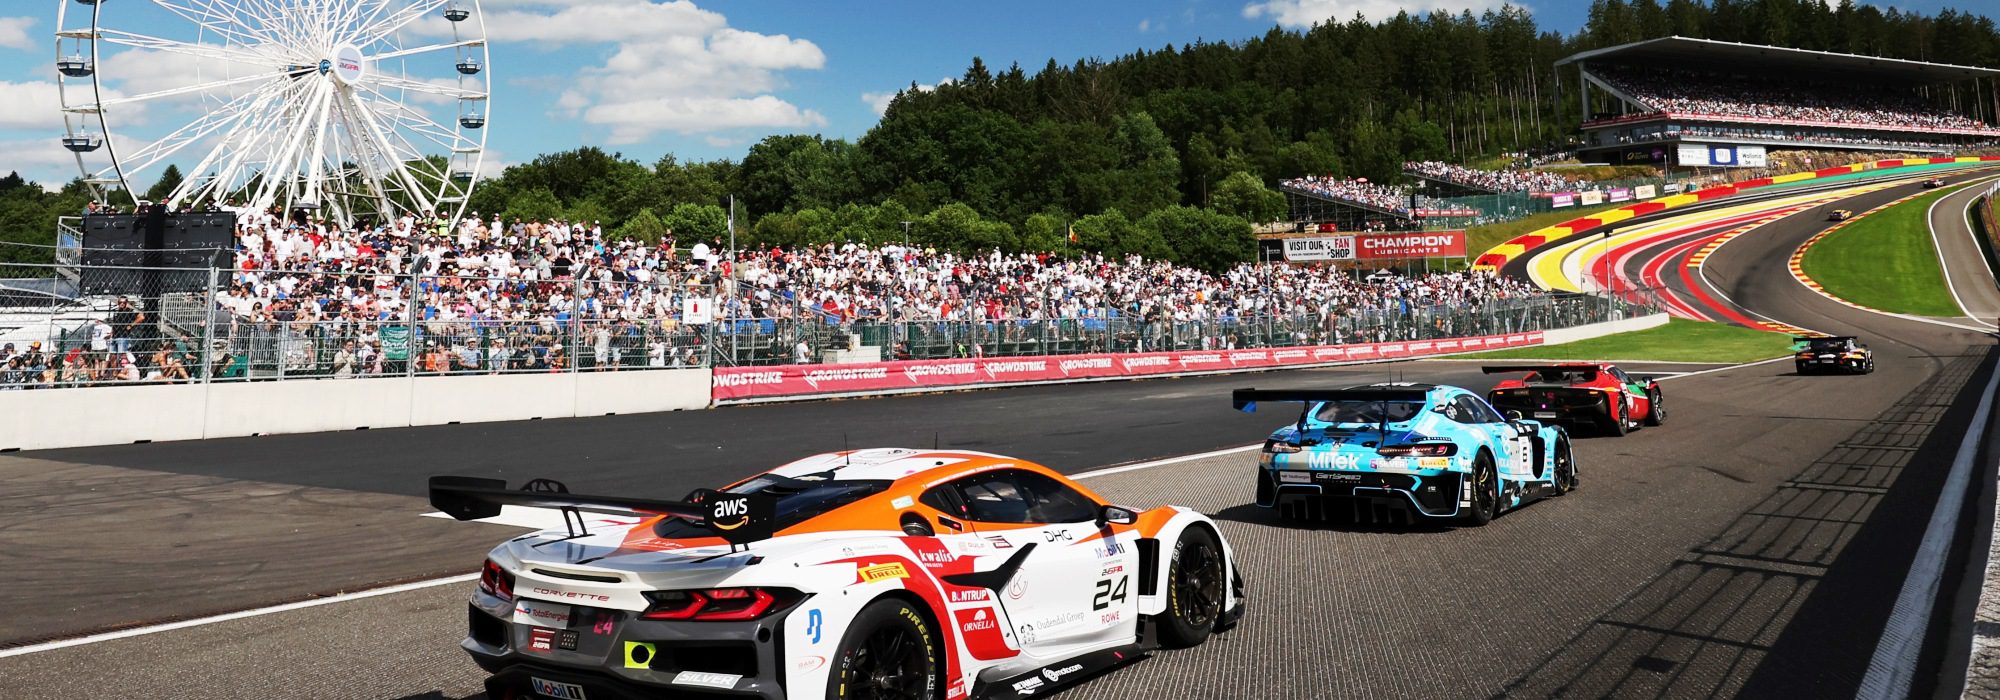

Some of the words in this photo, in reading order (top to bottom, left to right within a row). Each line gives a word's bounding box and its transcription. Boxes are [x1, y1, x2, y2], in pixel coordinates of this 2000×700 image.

[1289, 240, 1309, 251] VISIT
[1309, 239, 1324, 250] OUR
[1334, 238, 1350, 249] FAN
[1363, 235, 1452, 249] CHAMPION
[1330, 248, 1350, 259] SHOP
[1374, 246, 1439, 255] LUBRICANTS
[910, 362, 976, 376] CROWDSTRIKE
[987, 360, 1047, 373] CROWDSTRIKE
[1062, 358, 1113, 370] CROWDSTRIKE
[809, 367, 887, 382] CROWDSTRIKE
[714, 497, 748, 518] aws
[1043, 529, 1073, 543] DHG
[918, 549, 954, 562] kwalis
[865, 565, 904, 580] PIRELLI
[533, 587, 610, 602] CORVETTE
[1093, 575, 1129, 612] 24
[532, 608, 569, 622] TotalEnergies
[1101, 611, 1120, 624] ROWE
[963, 620, 995, 632] ORNELLA
[900, 607, 936, 663] PIRELLI
[678, 672, 734, 686] SILVER
[533, 678, 568, 699] Mobil
[569, 686, 579, 700] 1
